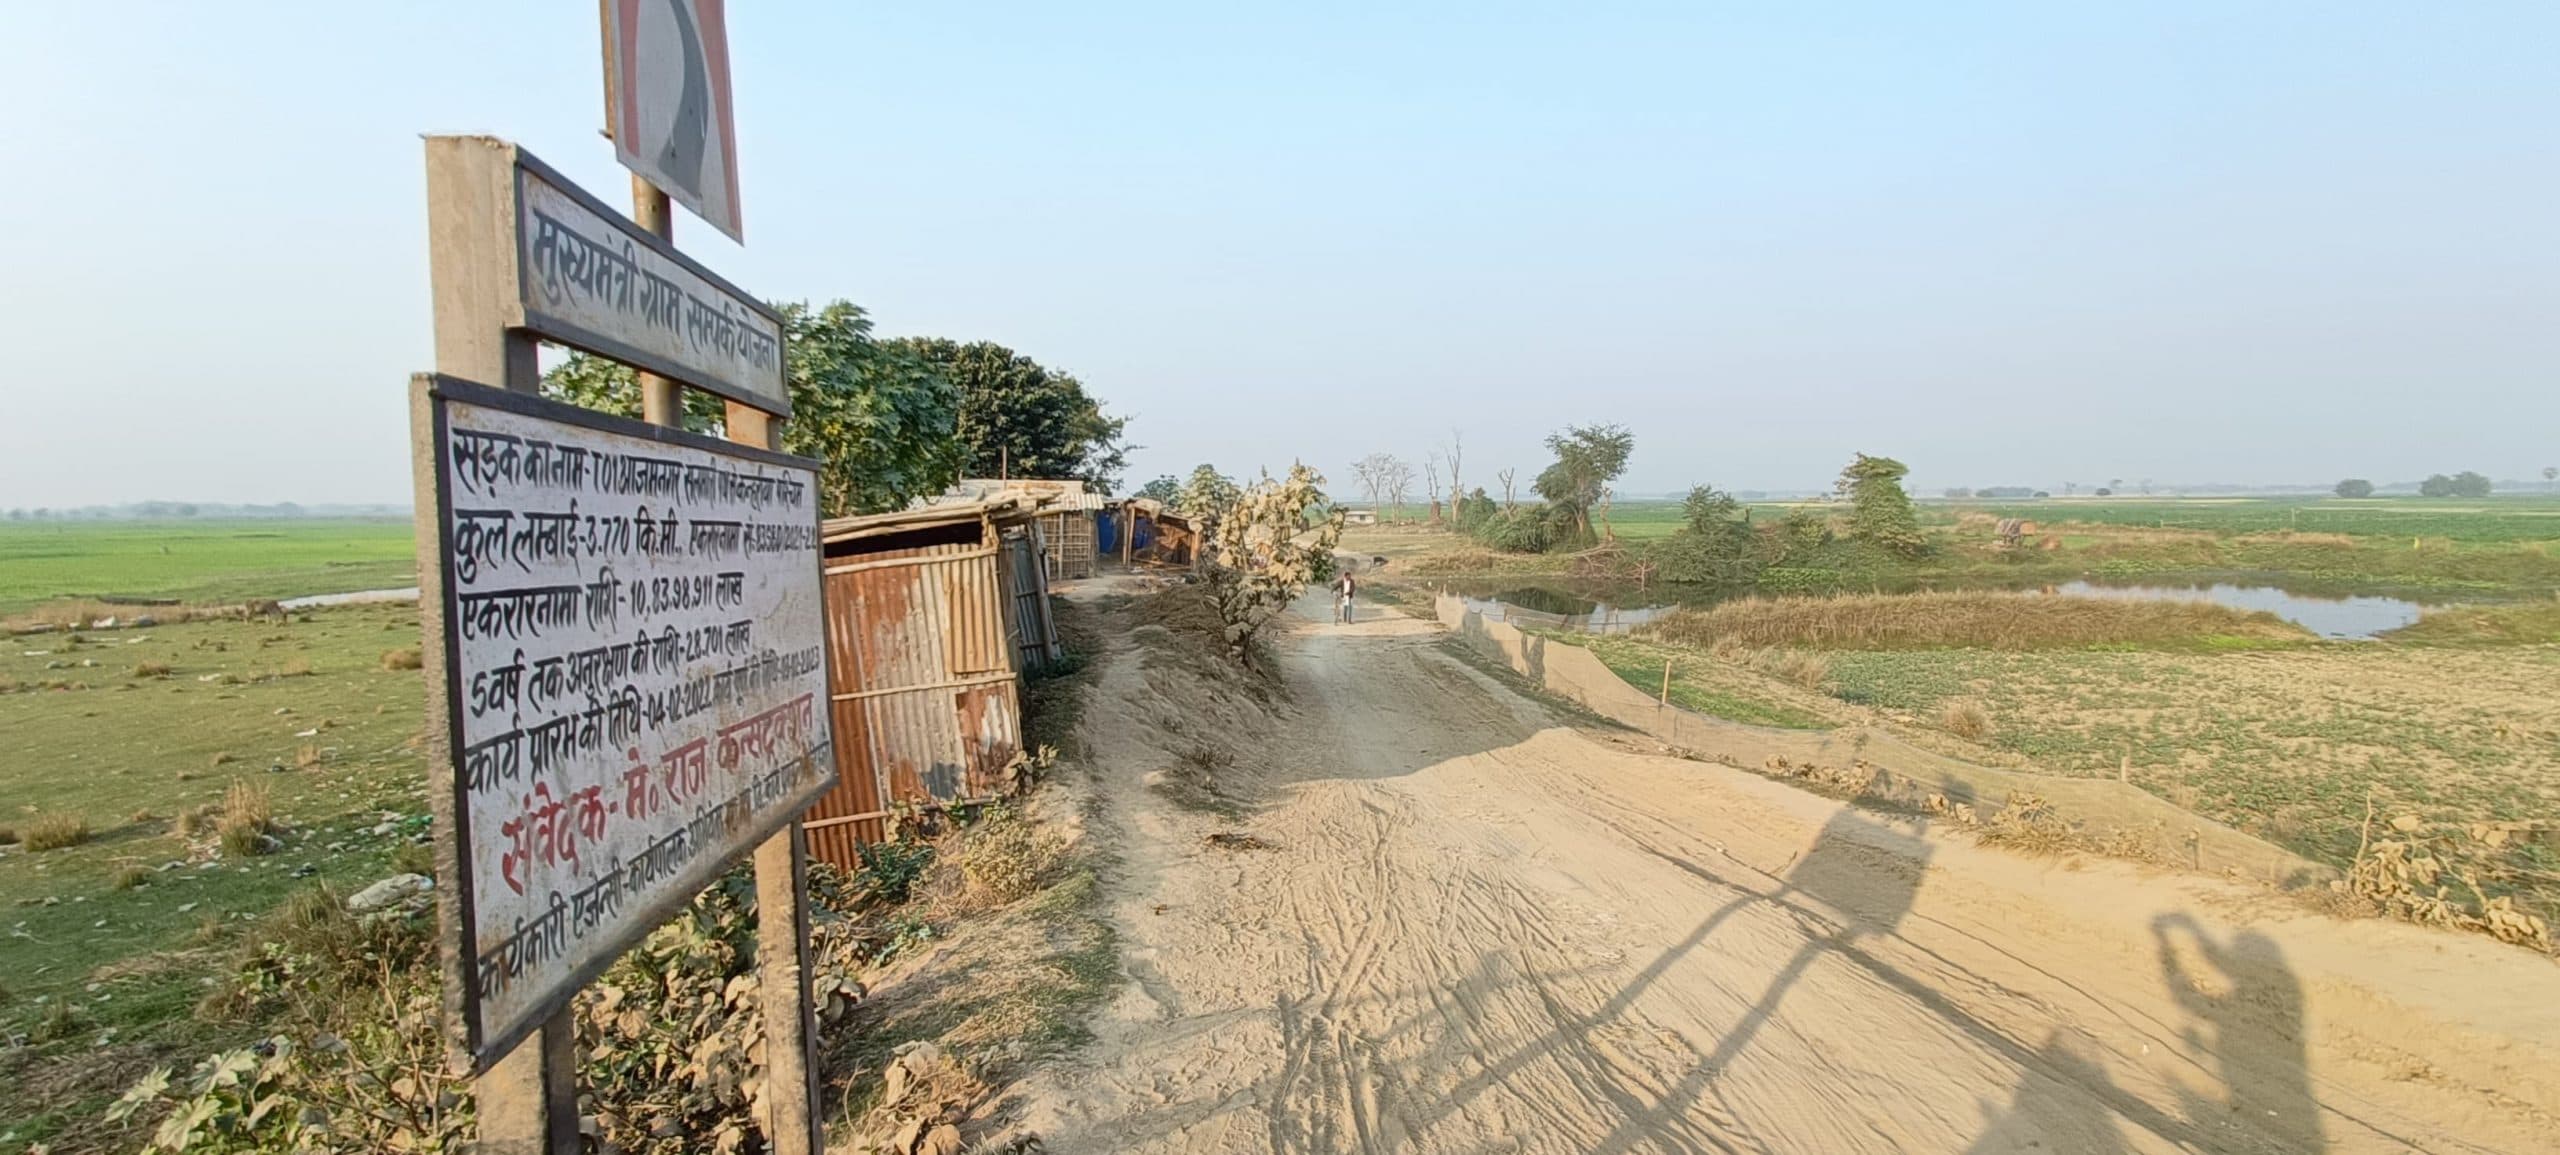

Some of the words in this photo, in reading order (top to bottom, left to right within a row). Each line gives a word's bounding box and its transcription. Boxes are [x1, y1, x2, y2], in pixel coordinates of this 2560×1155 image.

[532, 208, 639, 311] मुख्यमंत्री
[640, 267, 682, 336] ग्राम
[687, 289, 739, 359] सम्पर्क
[736, 307, 777, 372] योजना
[452, 428, 523, 498] सड़क
[523, 438, 553, 488] का
[455, 509, 515, 584] कुल
[459, 585, 583, 641] एकरारनामा
[715, 572, 744, 612] लाख
[528, 656, 564, 713] तक
[566, 643, 632, 699] अनुरक्षण
[631, 629, 652, 675] की
[725, 619, 753, 656] लाख
[465, 712, 525, 796] कार्य
[579, 690, 606, 752] की
[661, 736, 708, 806] राज
[478, 890, 569, 1000] कार्यकारी
